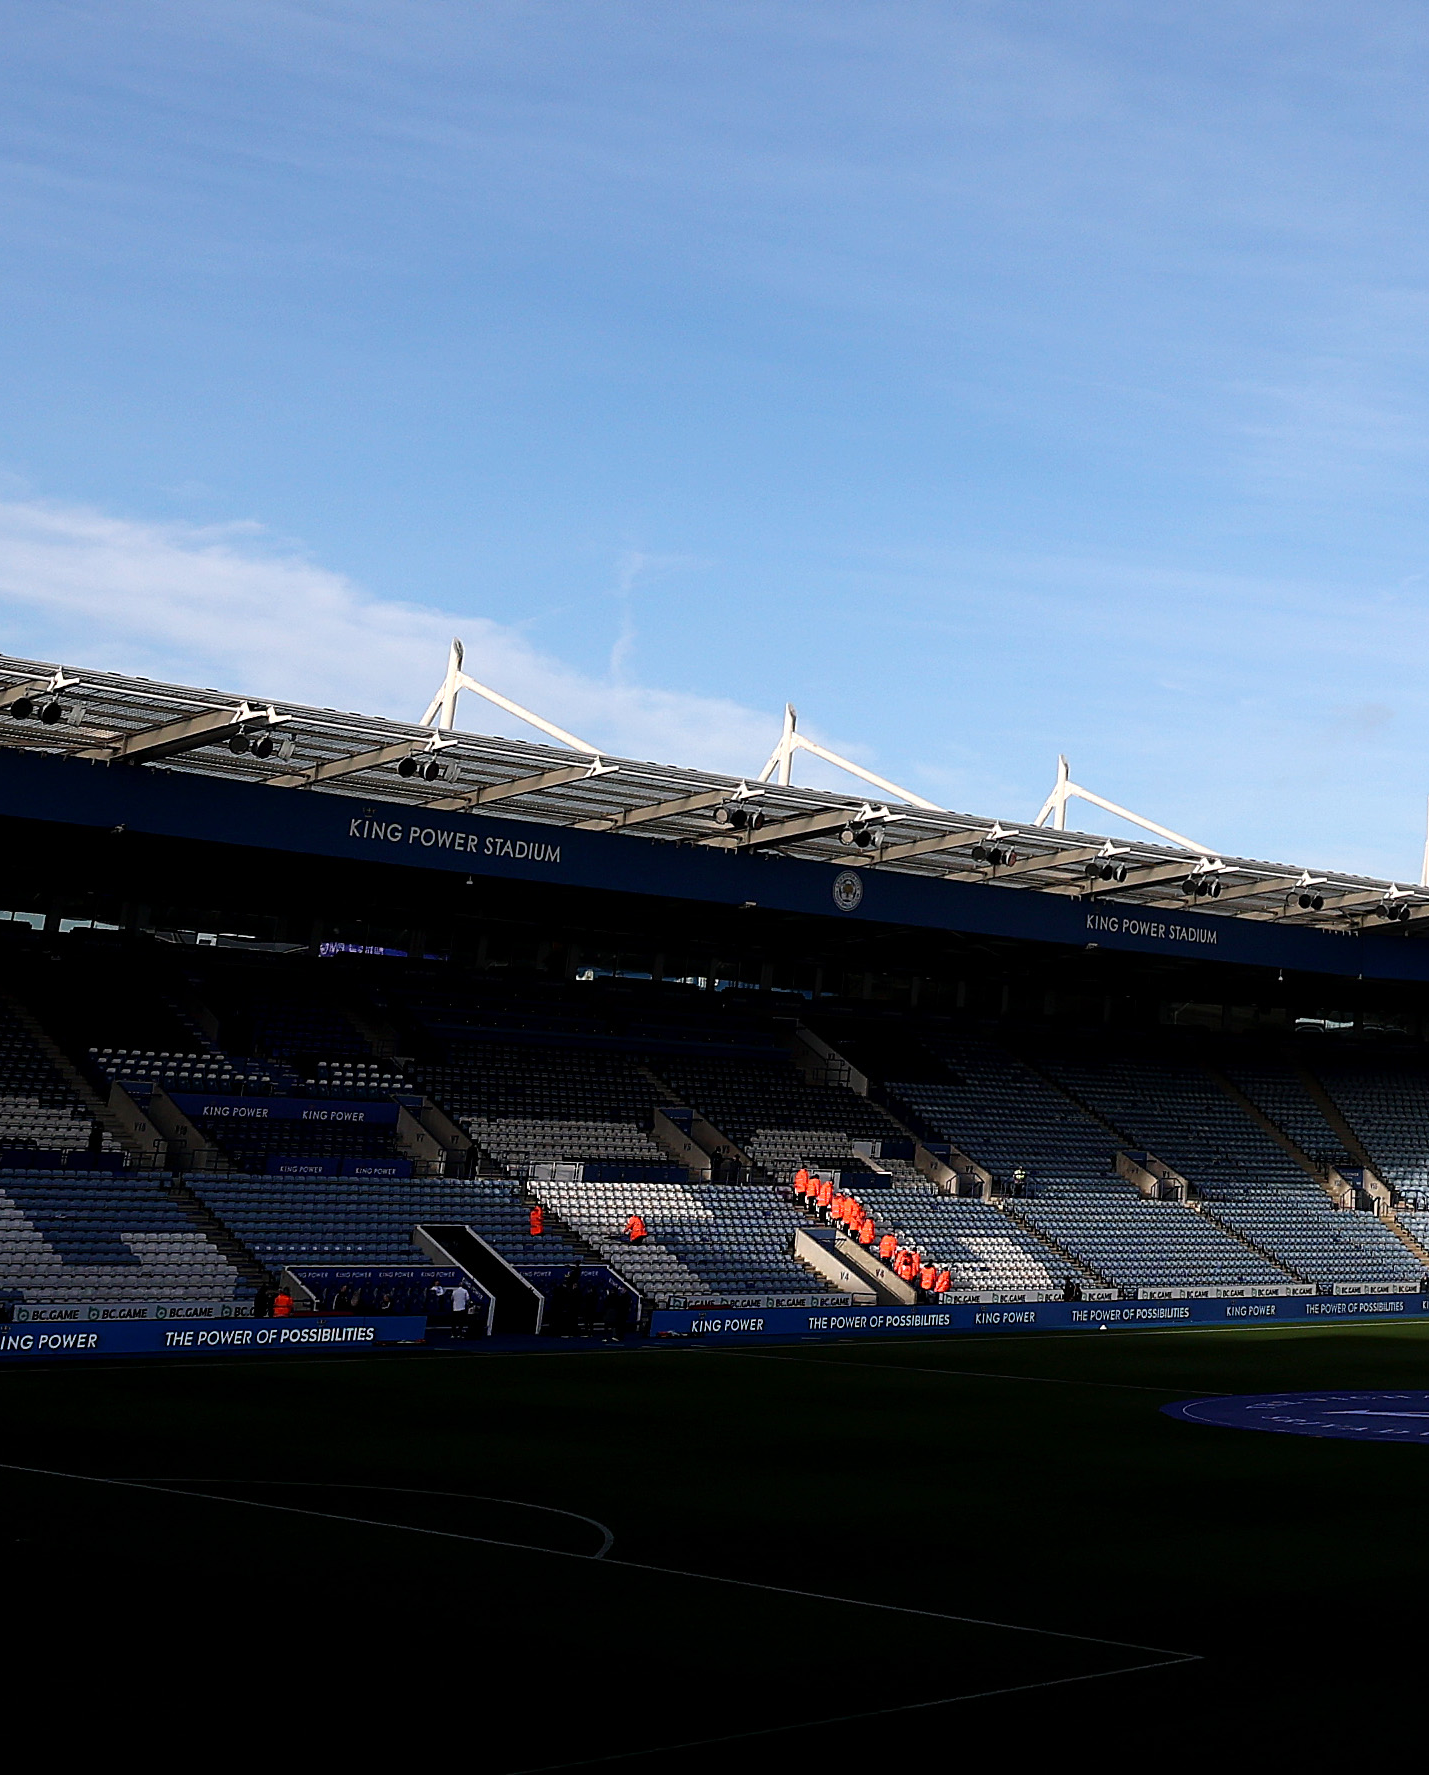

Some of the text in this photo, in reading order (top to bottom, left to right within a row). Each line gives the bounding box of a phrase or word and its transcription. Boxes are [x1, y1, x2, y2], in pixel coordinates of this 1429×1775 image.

[349, 818, 561, 863] KING POWER STADIUM
[1086, 913, 1218, 945] KING POWER STADIUM
[202, 1106, 269, 1119] KING POWER
[302, 1110, 365, 1122] KING POWER
[279, 1165, 323, 1174] KING POWER
[355, 1167, 397, 1175] KING POWER
[31, 1308, 80, 1320] BC.GAME
[101, 1307, 148, 1319] BC.GAME
[169, 1306, 213, 1318] BC.GAME
[1071, 1306, 1191, 1322] THE POWER OF POSSIBILITIES
[1225, 1304, 1277, 1317] KING POWER
[1305, 1300, 1405, 1315] THE POWER OF POSSIBILITIES
[808, 1313, 951, 1330] THE POWER OF POSSIBILITIES
[974, 1311, 1036, 1325] KING POWER
[691, 1318, 765, 1333] KING POWER
[38, 1332, 99, 1350] POWER
[164, 1326, 375, 1348] THE POWER OF POSSIBILITIES
